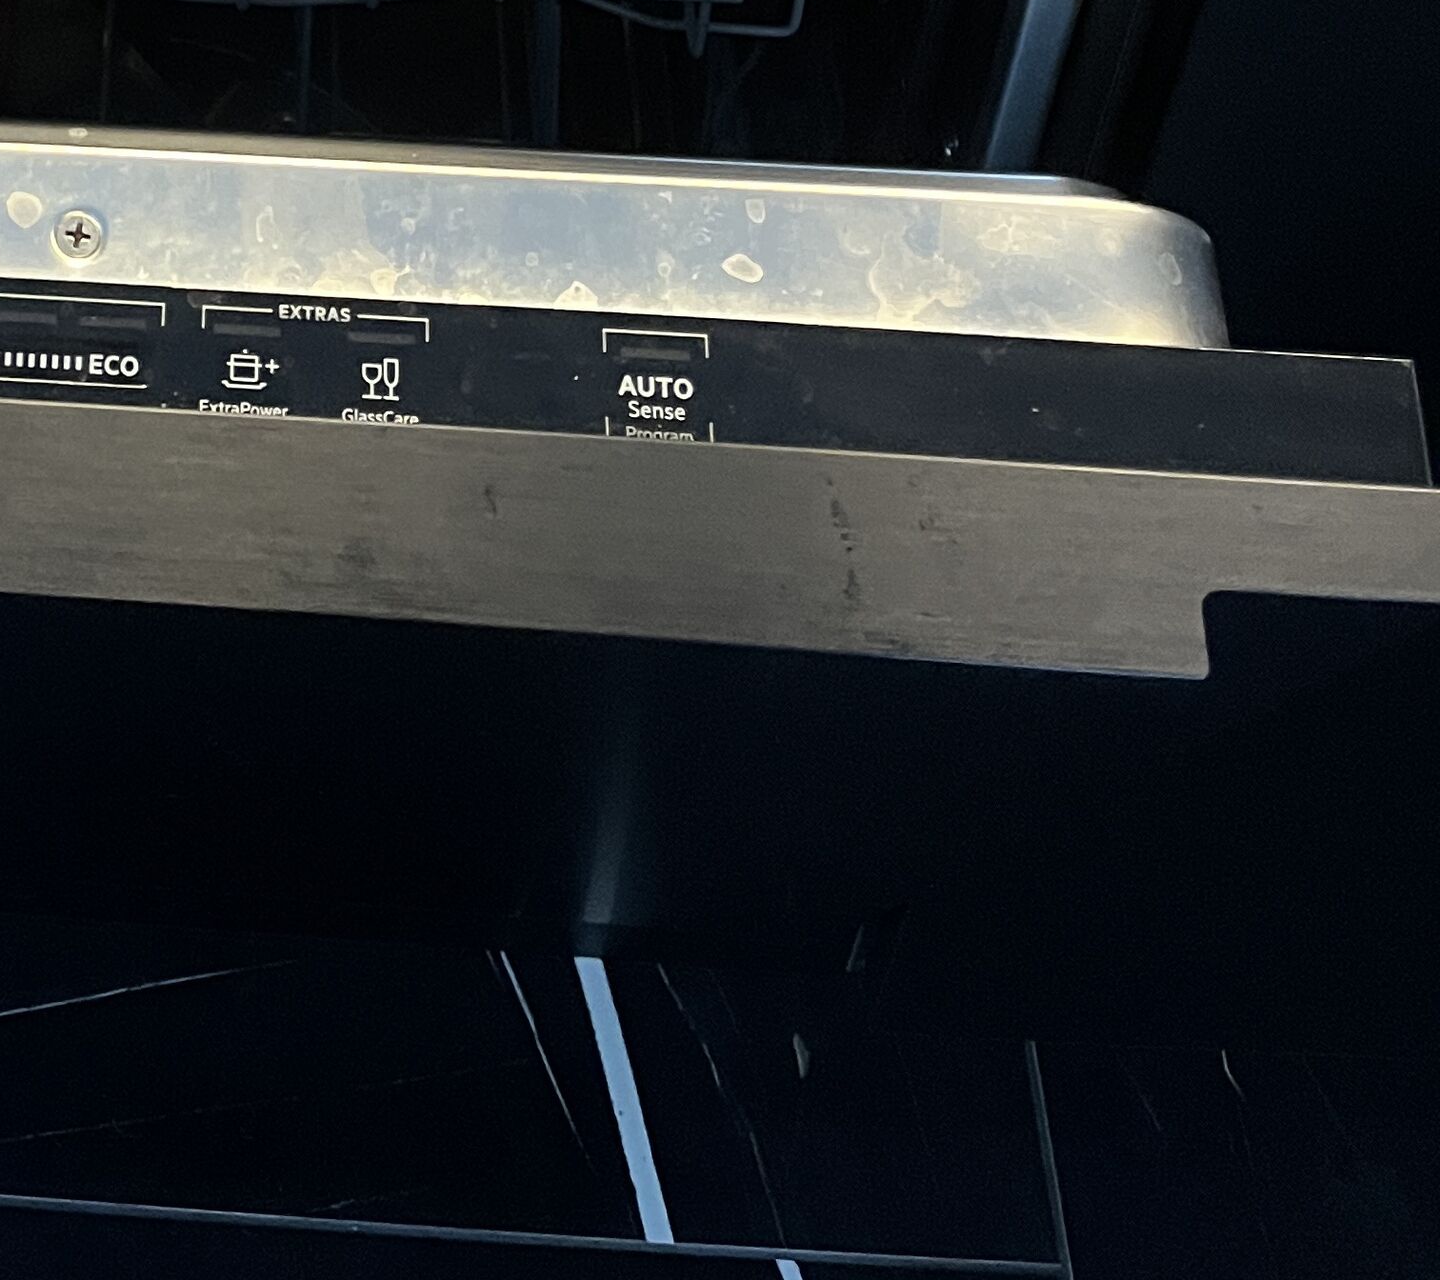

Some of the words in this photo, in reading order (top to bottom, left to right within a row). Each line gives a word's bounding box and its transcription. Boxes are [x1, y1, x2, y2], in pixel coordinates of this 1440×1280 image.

[278, 304, 351, 323] EXTRAS
[88, 354, 140, 377] ECO
[618, 375, 694, 400] AUTO
[199, 399, 288, 418] ExtraPower
[341, 408, 419, 426] GlassCare
[628, 400, 686, 421] Sense
